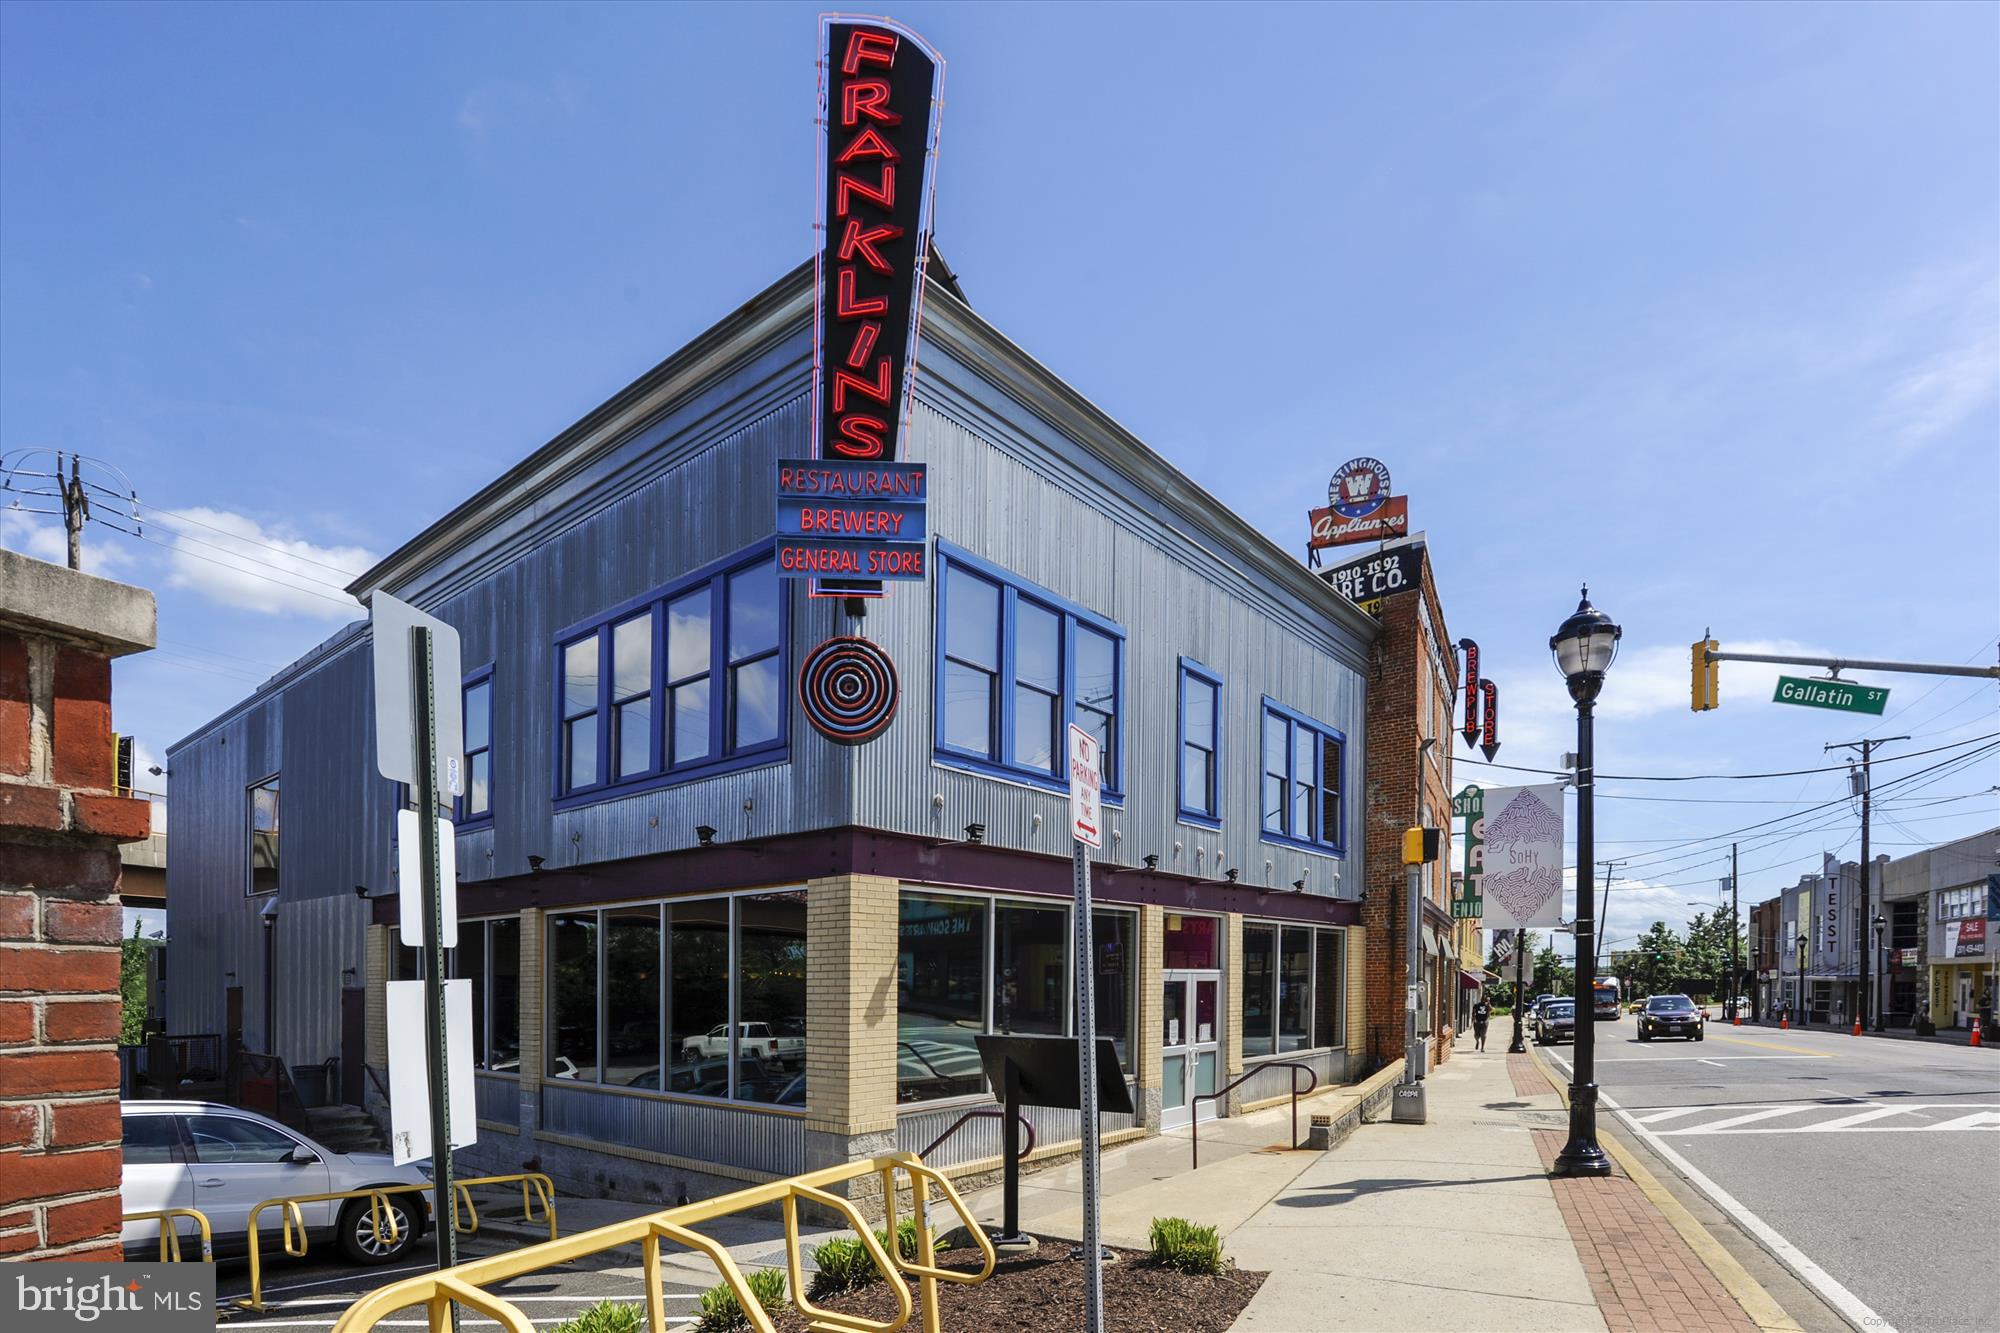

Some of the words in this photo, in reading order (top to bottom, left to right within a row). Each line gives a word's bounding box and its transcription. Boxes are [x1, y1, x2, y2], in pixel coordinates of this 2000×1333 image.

[832, 28, 903, 459] FRANKLINS
[780, 467, 923, 496] RESTAURANT
[1330, 458, 1391, 506] WESTINGHOUSE
[1345, 472, 1374, 497] W
[801, 508, 903, 533] BREWERY
[1313, 514, 1405, 540] Appliances
[781, 547, 860, 572] GENERAL
[868, 550, 922, 574] STORE
[1372, 568, 1408, 593] CO.
[1466, 647, 1477, 734] BREWPUB
[1782, 682, 1853, 706] Gallatin
[1867, 690, 1883, 701] ST
[1484, 683, 1495, 746] STORE
[1079, 738, 1090, 762] NO
[1073, 761, 1098, 791] PARKING
[1081, 787, 1091, 803] ANY
[1081, 802, 1092, 821] TIME
[1827, 877, 1838, 953] TESST
